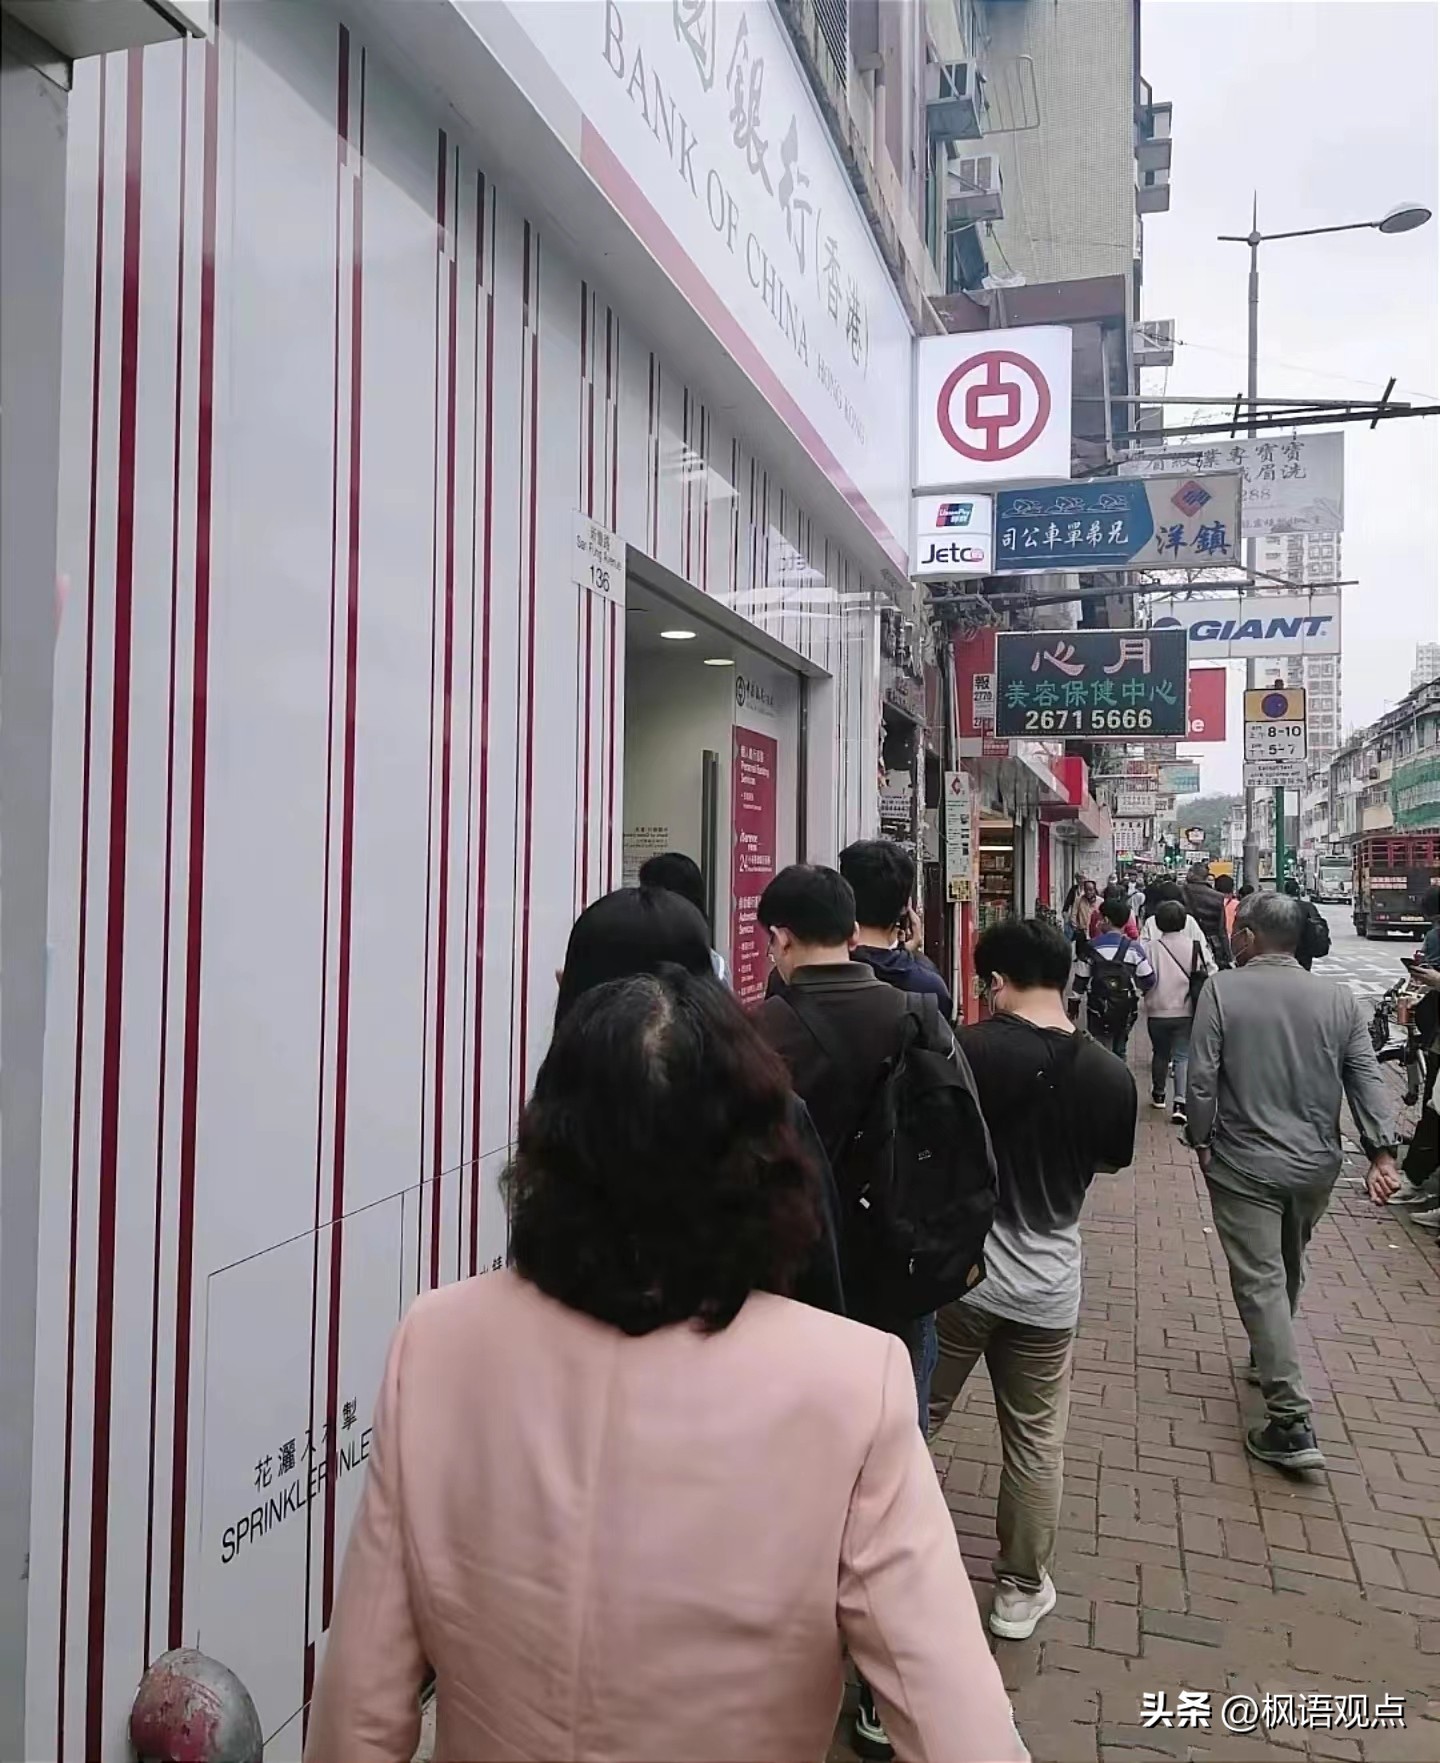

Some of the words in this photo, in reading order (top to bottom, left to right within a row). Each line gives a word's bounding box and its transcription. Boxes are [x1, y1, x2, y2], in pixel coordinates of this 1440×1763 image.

[602, 0, 698, 199] BANK
[707, 168, 740, 254] OF
[747, 232, 808, 368] CHINA
[590, 565, 610, 592] 136
[1190, 616, 1332, 641] GIANT
[1004, 677, 1178, 709] 美容保健中心
[1025, 709, 1083, 730] 2671
[1091, 708, 1153, 729] 5666
[1268, 726, 1302, 738] 8-10
[1269, 743, 1295, 756] 5-7
[335, 1426, 374, 1481] INLE
